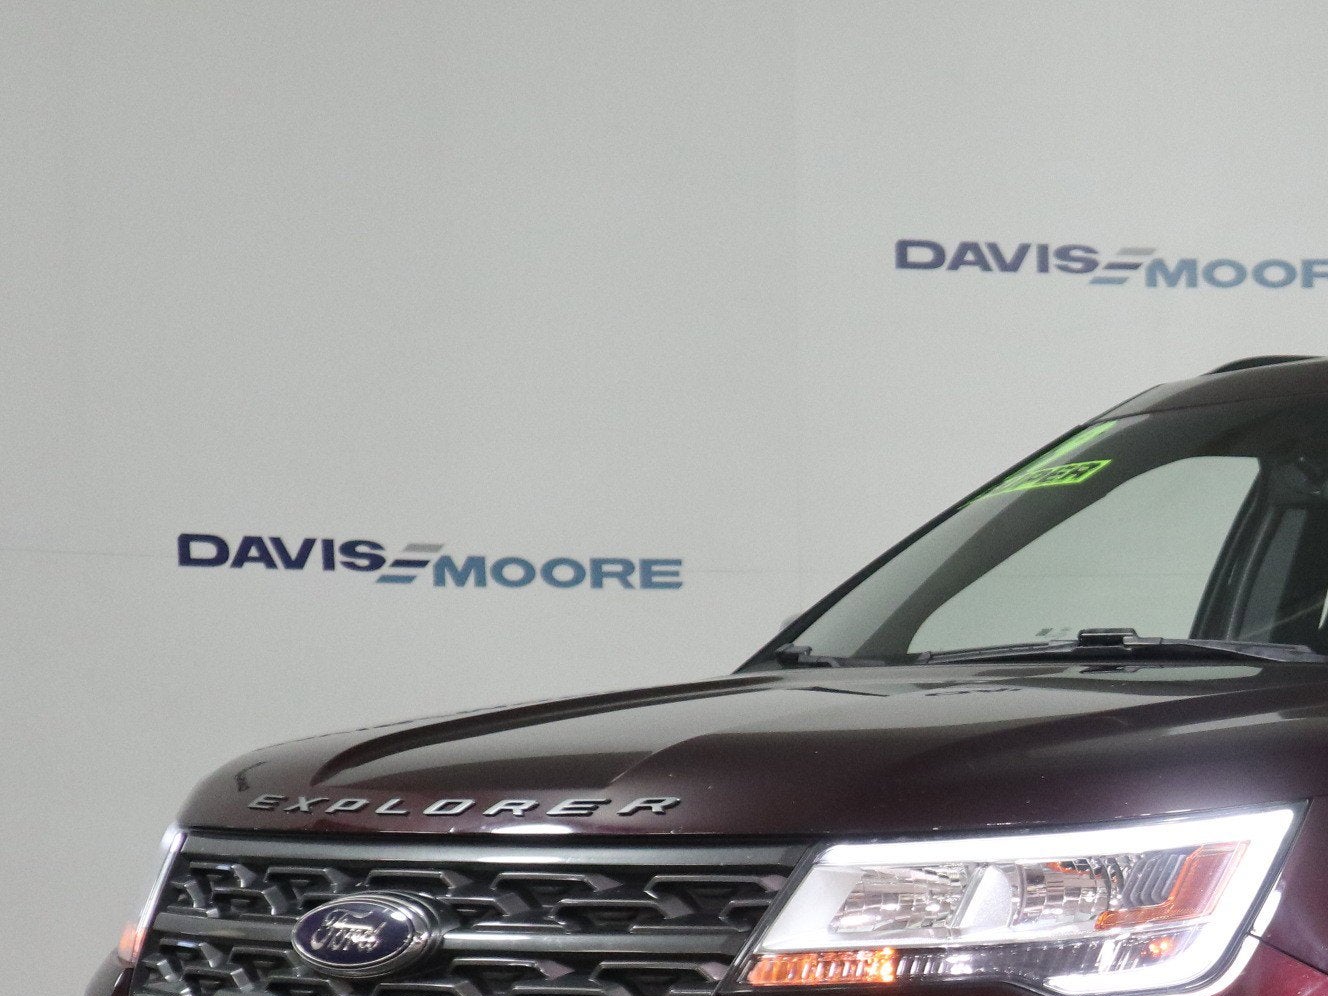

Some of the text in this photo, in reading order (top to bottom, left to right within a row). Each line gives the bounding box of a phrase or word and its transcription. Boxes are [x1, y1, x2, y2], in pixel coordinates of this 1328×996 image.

[895, 239, 1100, 274] DAVIS
[177, 533, 684, 589] DAVIS MOORE
[247, 793, 683, 818] EXPLORER
[310, 908, 387, 952] Ford
